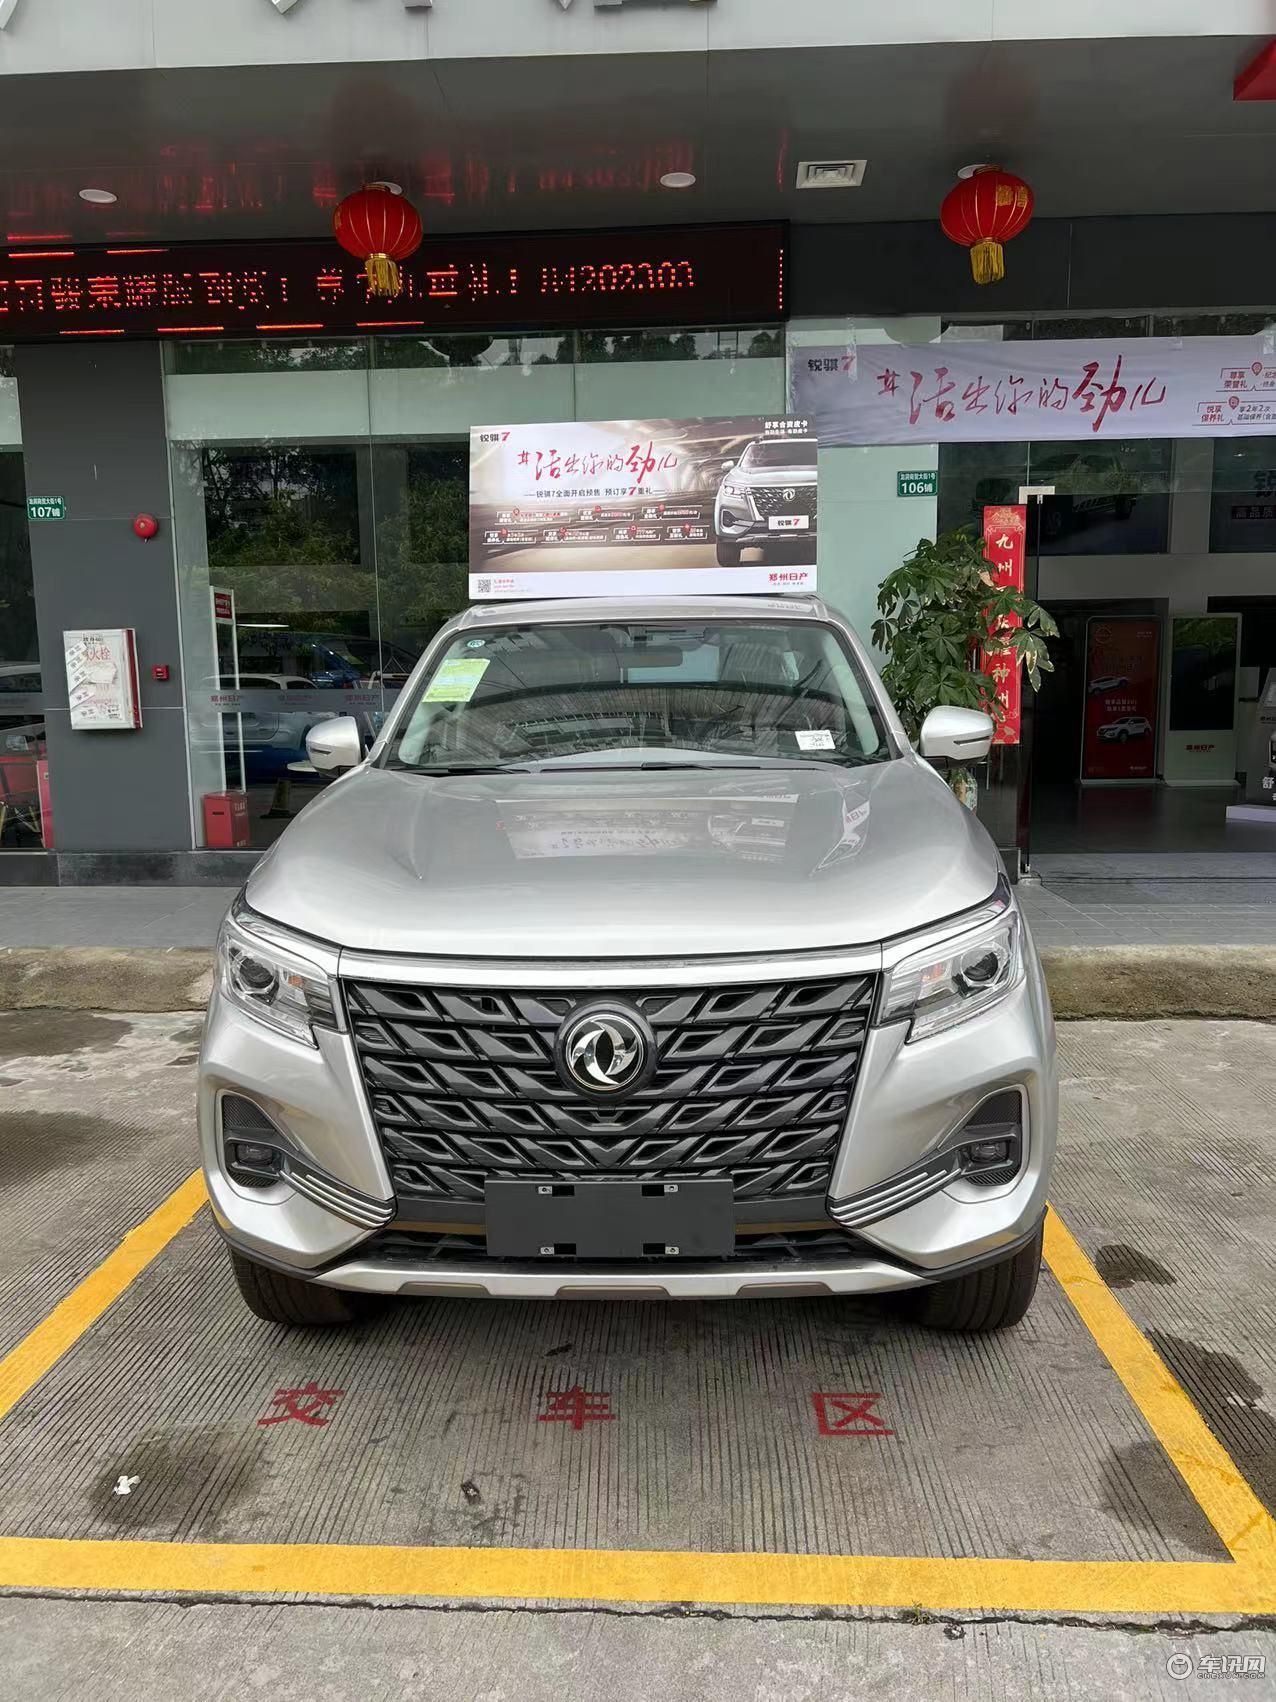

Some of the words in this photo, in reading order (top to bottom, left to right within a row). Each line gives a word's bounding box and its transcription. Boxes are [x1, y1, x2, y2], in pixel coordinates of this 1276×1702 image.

[808, 356, 855, 372] 锐骐7
[479, 431, 511, 442] 锐骐7
[768, 572, 808, 581] 郑州日产
